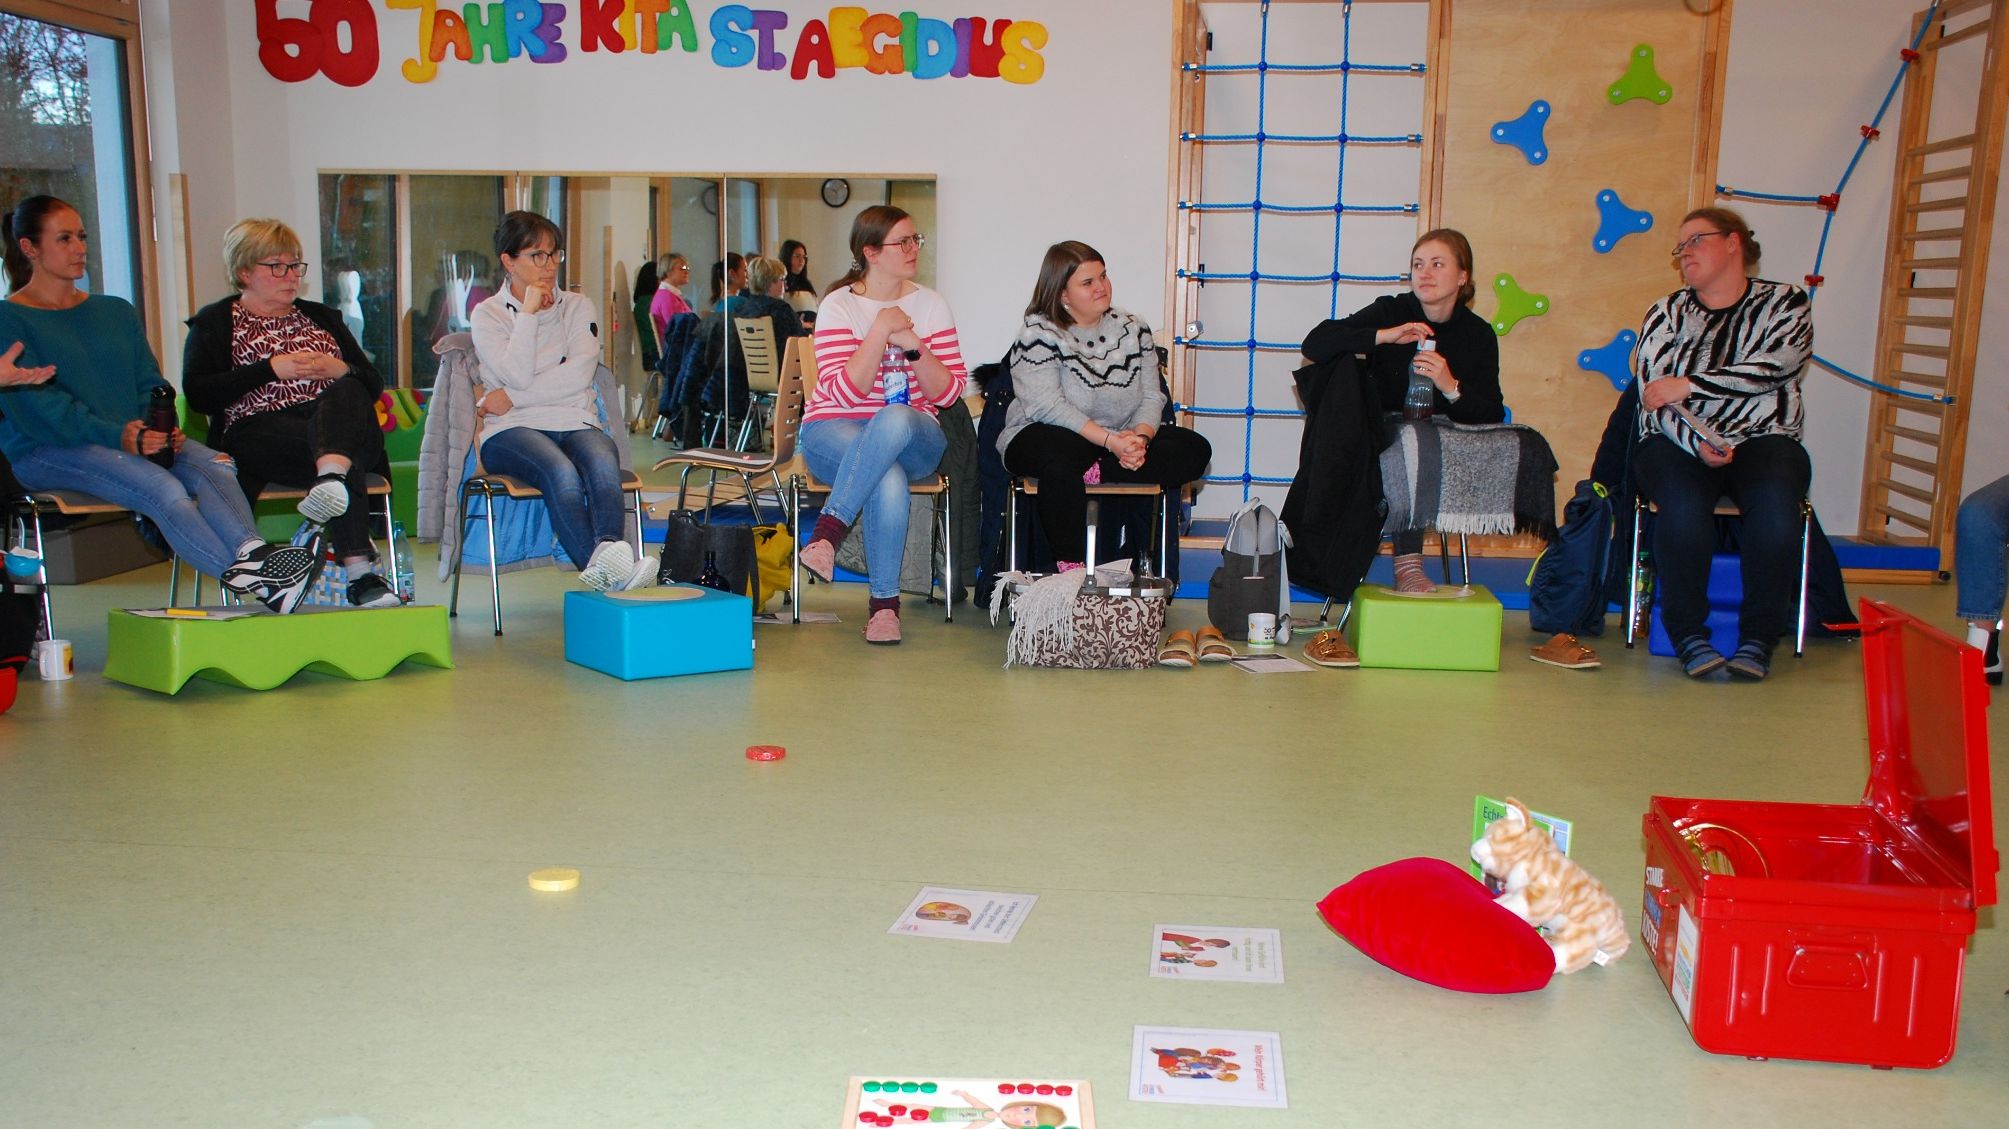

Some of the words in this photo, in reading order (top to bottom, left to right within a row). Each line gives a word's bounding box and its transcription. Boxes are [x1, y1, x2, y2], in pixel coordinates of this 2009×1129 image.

[386, 0, 567, 84] JAHRE
[580, 0, 698, 54] KITA
[709, 4, 788, 71] ST.
[790, 6, 1050, 85] AEGIDIUS
[1483, 806, 1503, 821] Echt
